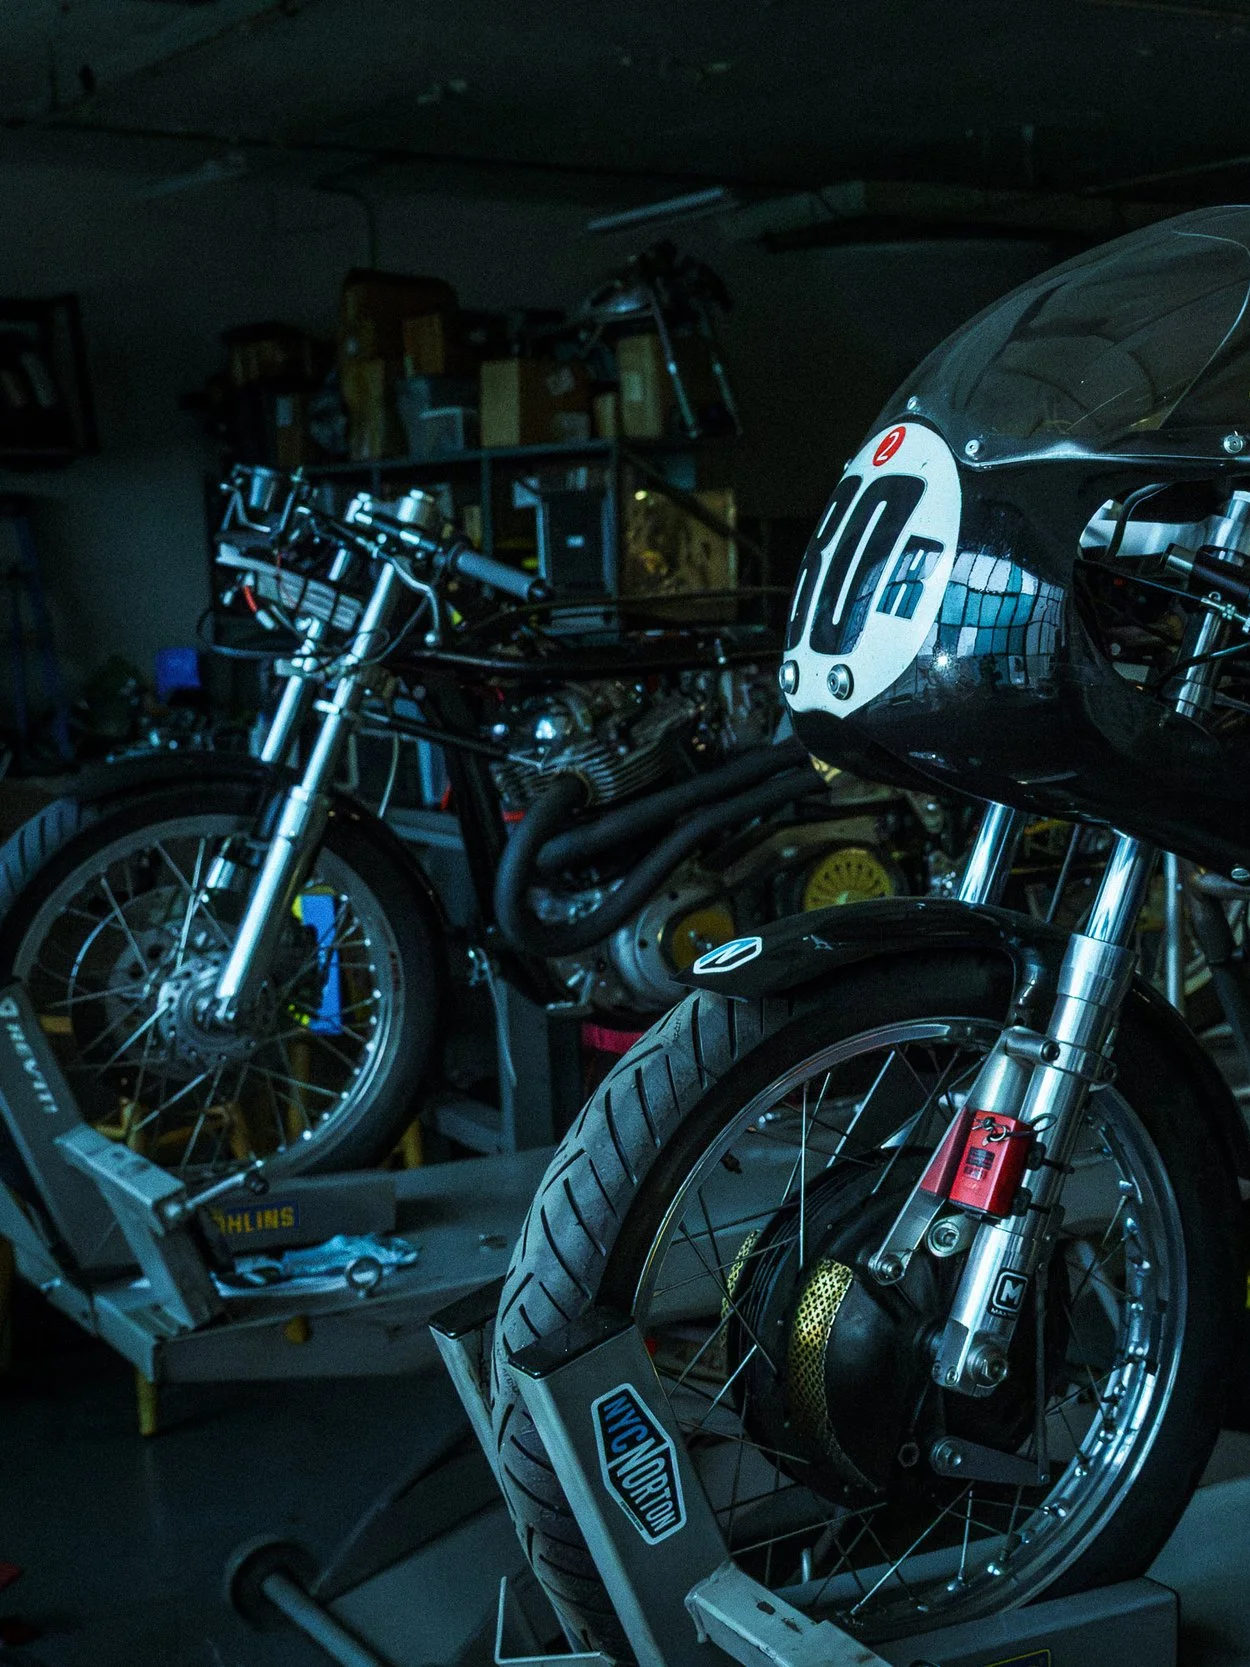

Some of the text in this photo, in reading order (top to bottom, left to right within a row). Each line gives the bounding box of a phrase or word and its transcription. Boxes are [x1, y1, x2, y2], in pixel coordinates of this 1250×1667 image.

[876, 431, 899, 461] 2
[875, 534, 946, 620] R
[603, 1395, 649, 1454] NYC
[608, 1437, 677, 1532] NORTON
